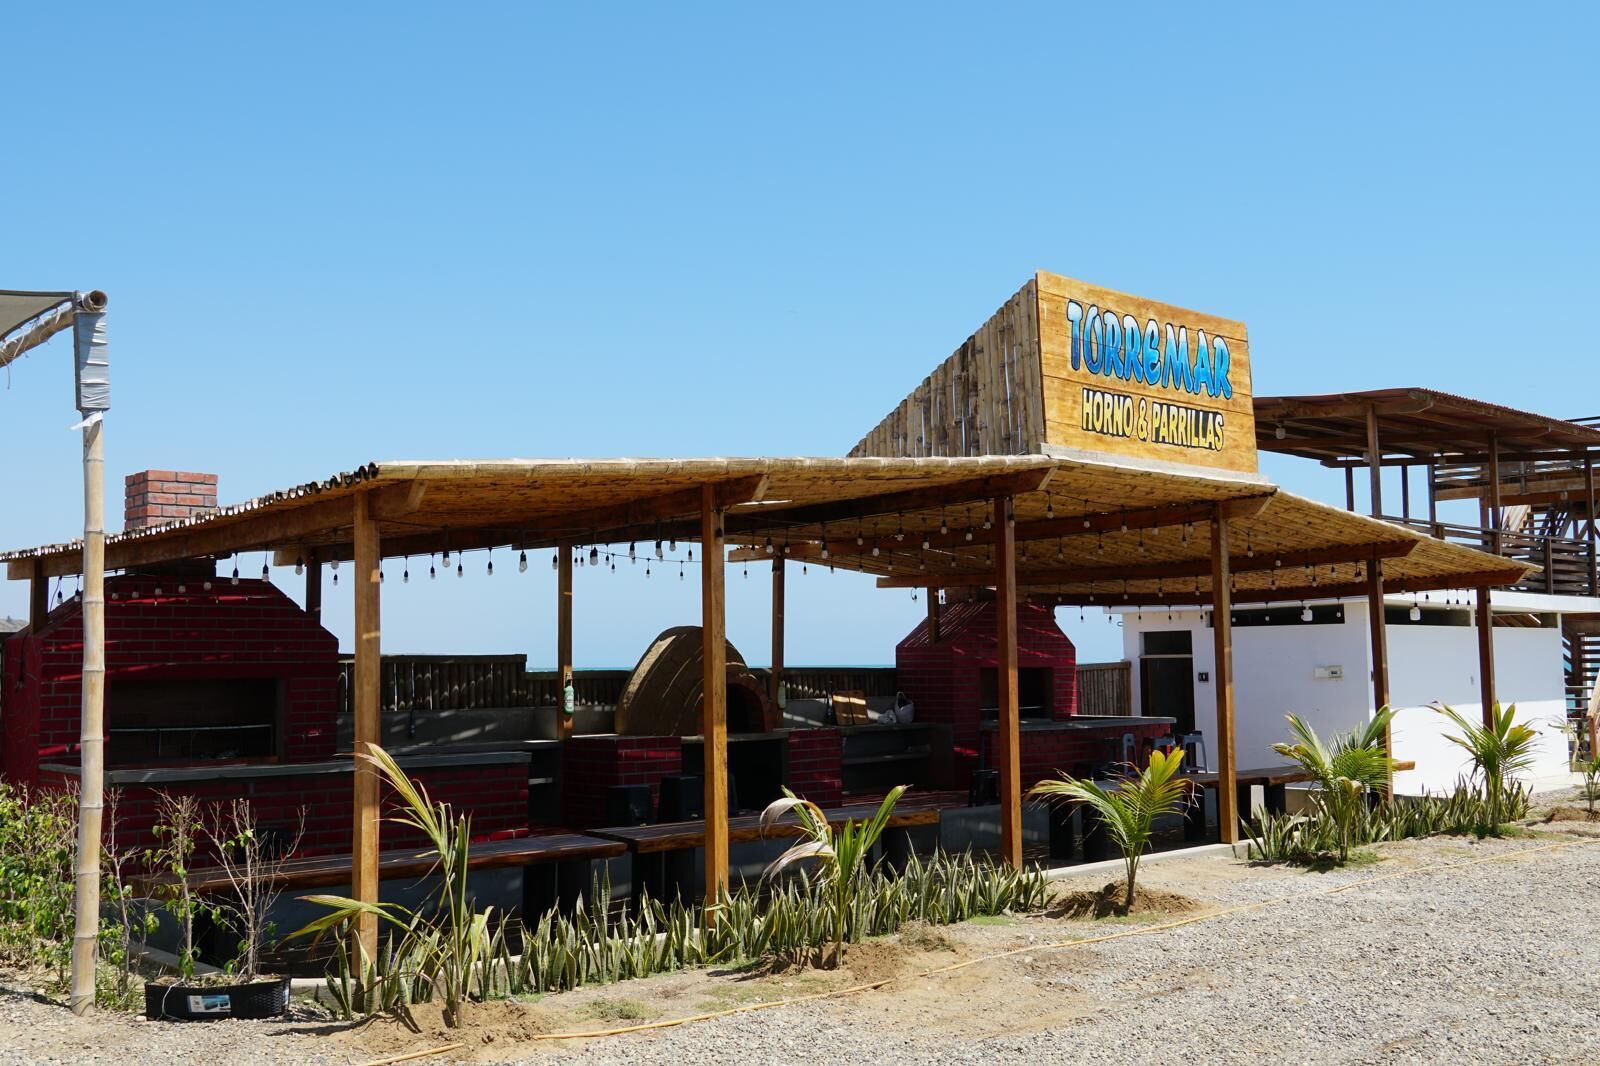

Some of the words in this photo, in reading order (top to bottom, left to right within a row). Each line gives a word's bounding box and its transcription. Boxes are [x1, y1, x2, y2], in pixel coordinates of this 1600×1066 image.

[1066, 299, 1232, 400] TORREMAR
[1082, 388, 1134, 438] HORNO
[1137, 397, 1148, 442] &
[1151, 402, 1224, 451] PARRILLAS
